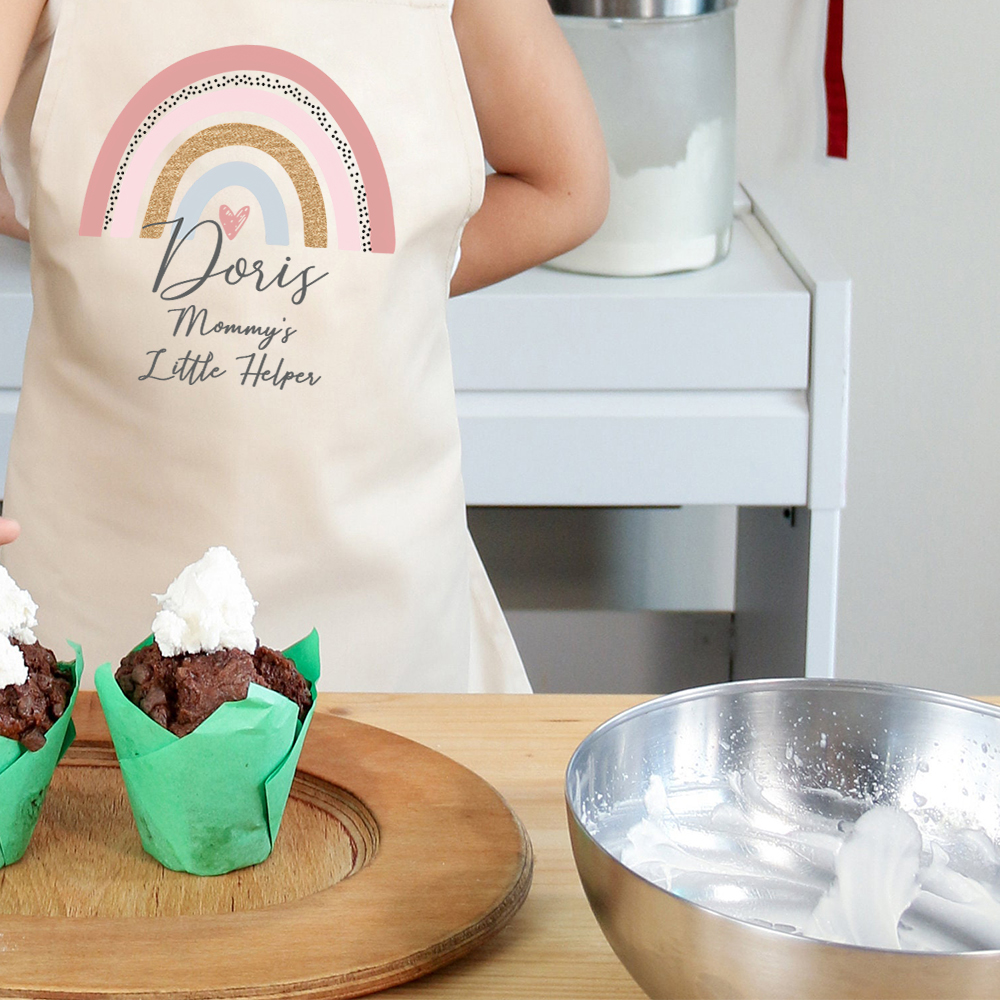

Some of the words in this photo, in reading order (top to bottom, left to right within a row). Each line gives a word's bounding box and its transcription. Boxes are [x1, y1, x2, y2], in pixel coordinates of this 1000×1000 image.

[142, 216, 330, 305] Doris
[167, 304, 298, 351] Mommy's
[137, 348, 227, 386] Little
[235, 352, 322, 391] Helper
